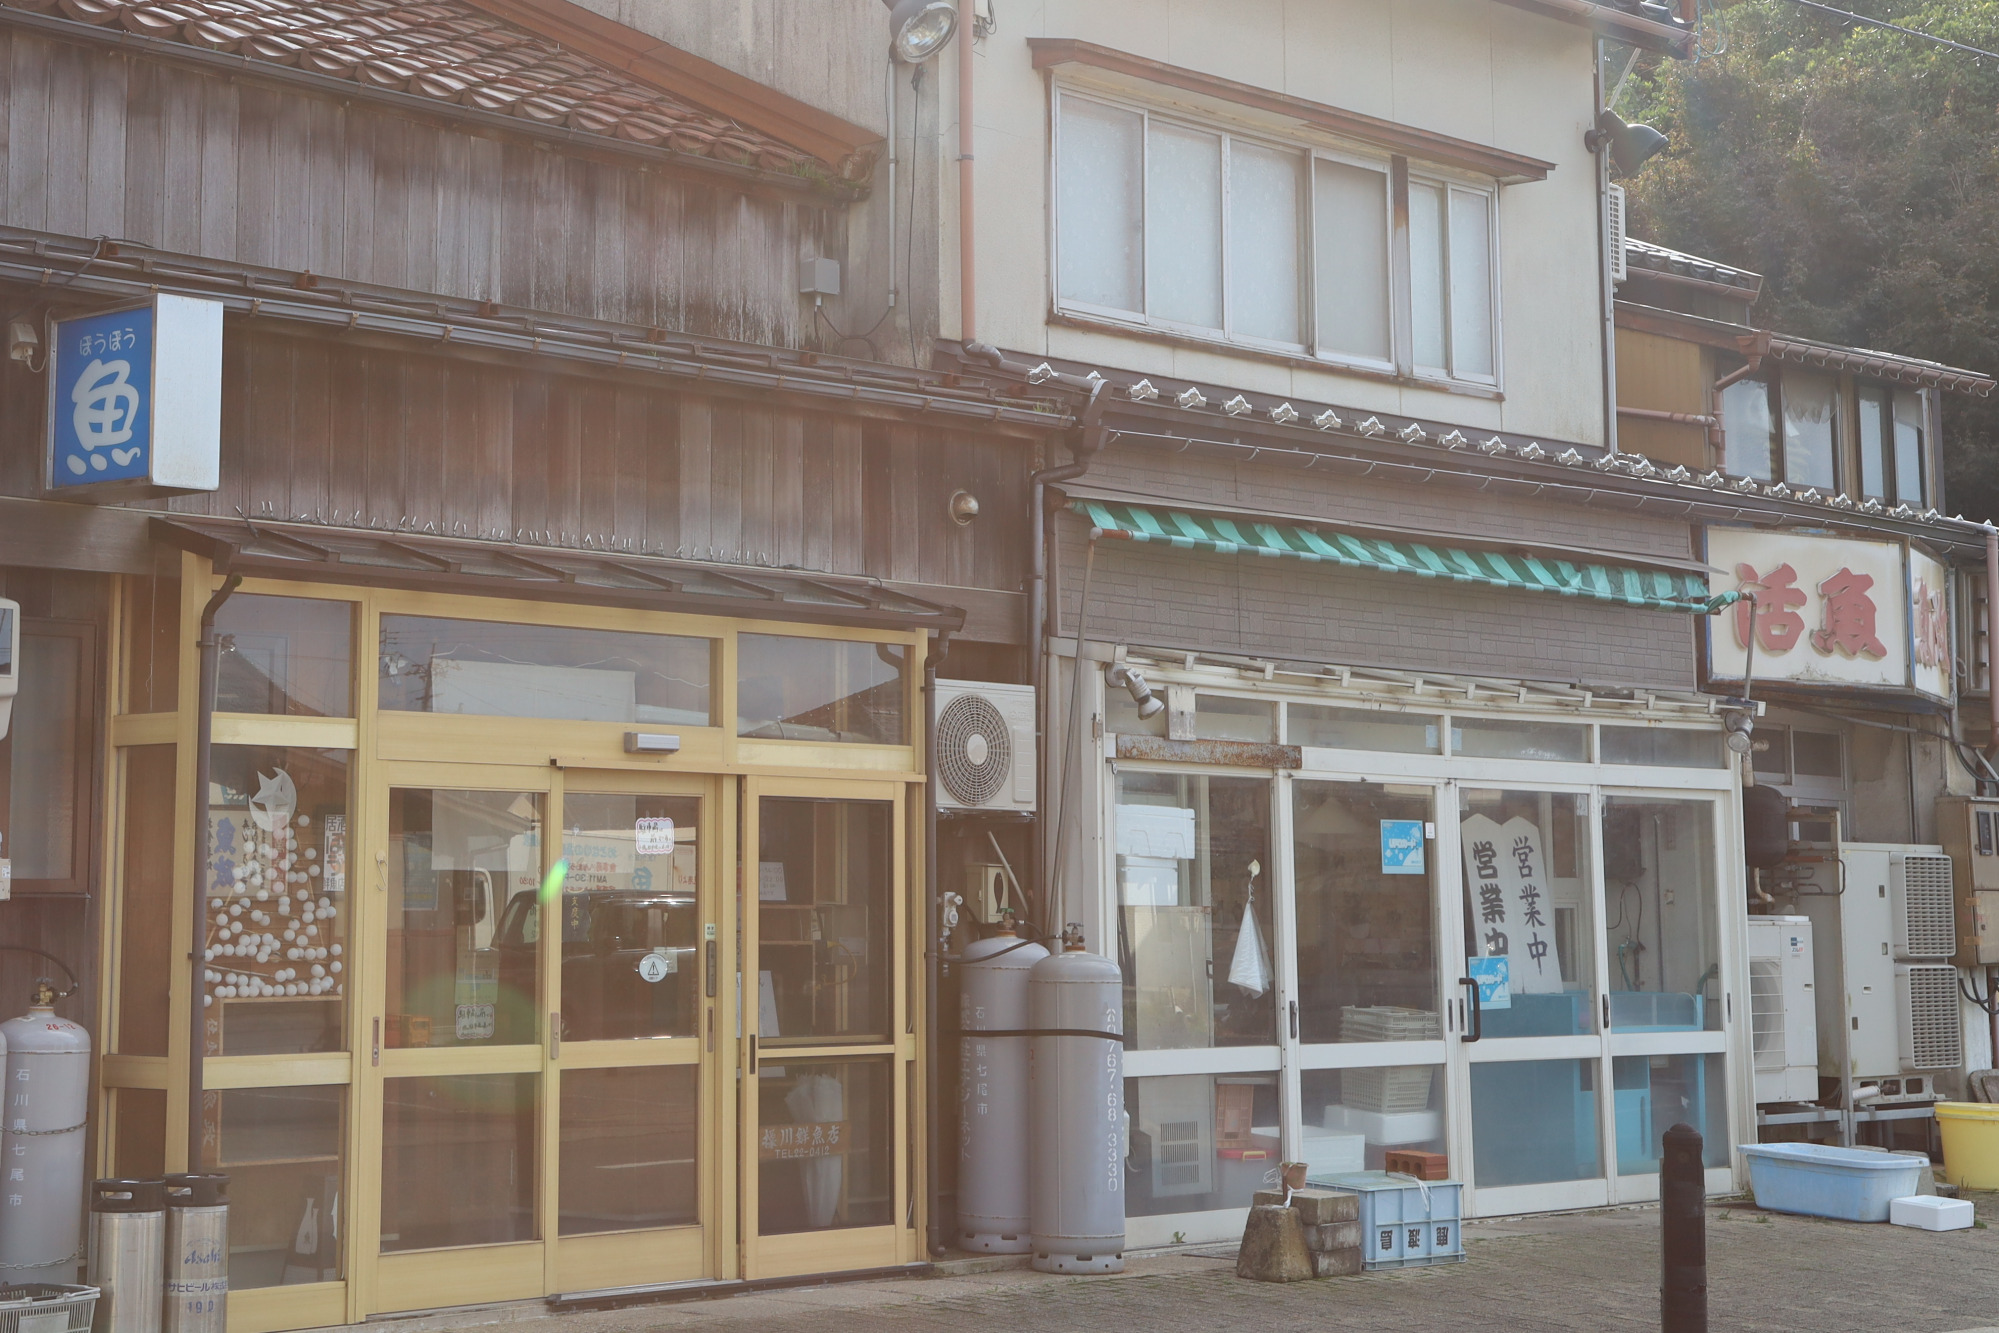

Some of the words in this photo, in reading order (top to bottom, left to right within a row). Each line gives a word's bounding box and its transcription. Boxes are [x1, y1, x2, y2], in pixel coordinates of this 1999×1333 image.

[79, 327, 136, 357] ぼうぼう
[66, 358, 141, 476] 魚
[1734, 561, 1888, 658] 活魚
[570, 896, 580, 931] 支度中
[1473, 840, 1509, 957] 営業中
[1512, 836, 1548, 976] 営業中
[8, 1068, 31, 1208] 石川県七尾市
[184, 1247, 221, 1265] Asahi
[1380, 1226, 1449, 1251] 鹿渡島
